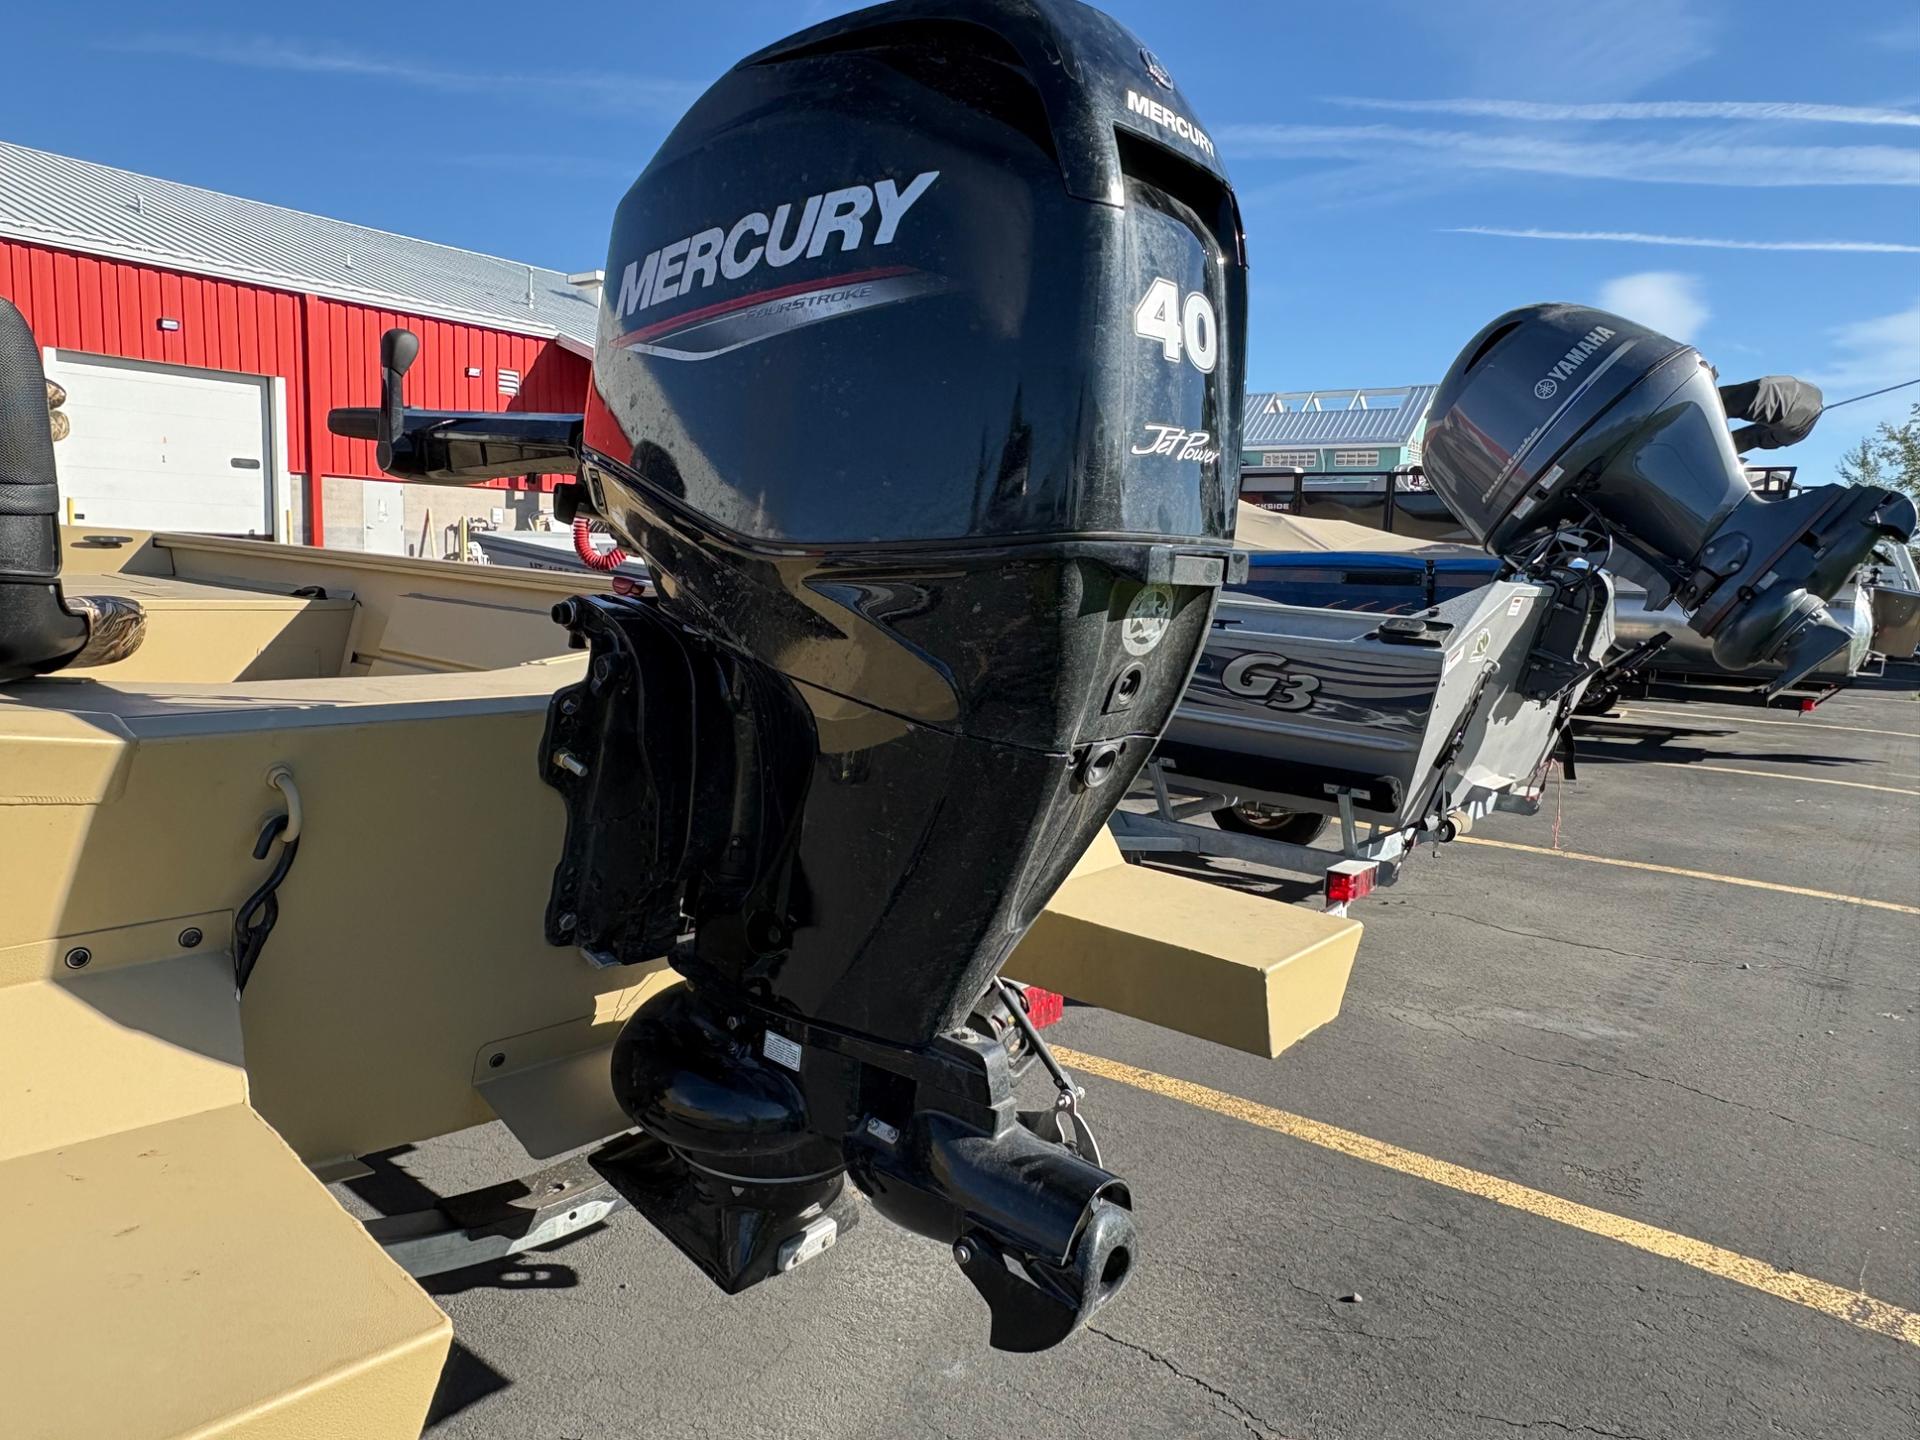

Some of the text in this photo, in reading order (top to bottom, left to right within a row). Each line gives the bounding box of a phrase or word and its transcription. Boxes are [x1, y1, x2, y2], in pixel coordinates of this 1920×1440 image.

[1127, 90, 1215, 158] MERCURY
[615, 171, 940, 321] MERCURY
[746, 285, 873, 319] FOURSTROKE
[1134, 277, 1217, 374] 40
[1548, 325, 1617, 381] YAMAHA
[1221, 651, 1322, 712] G3
